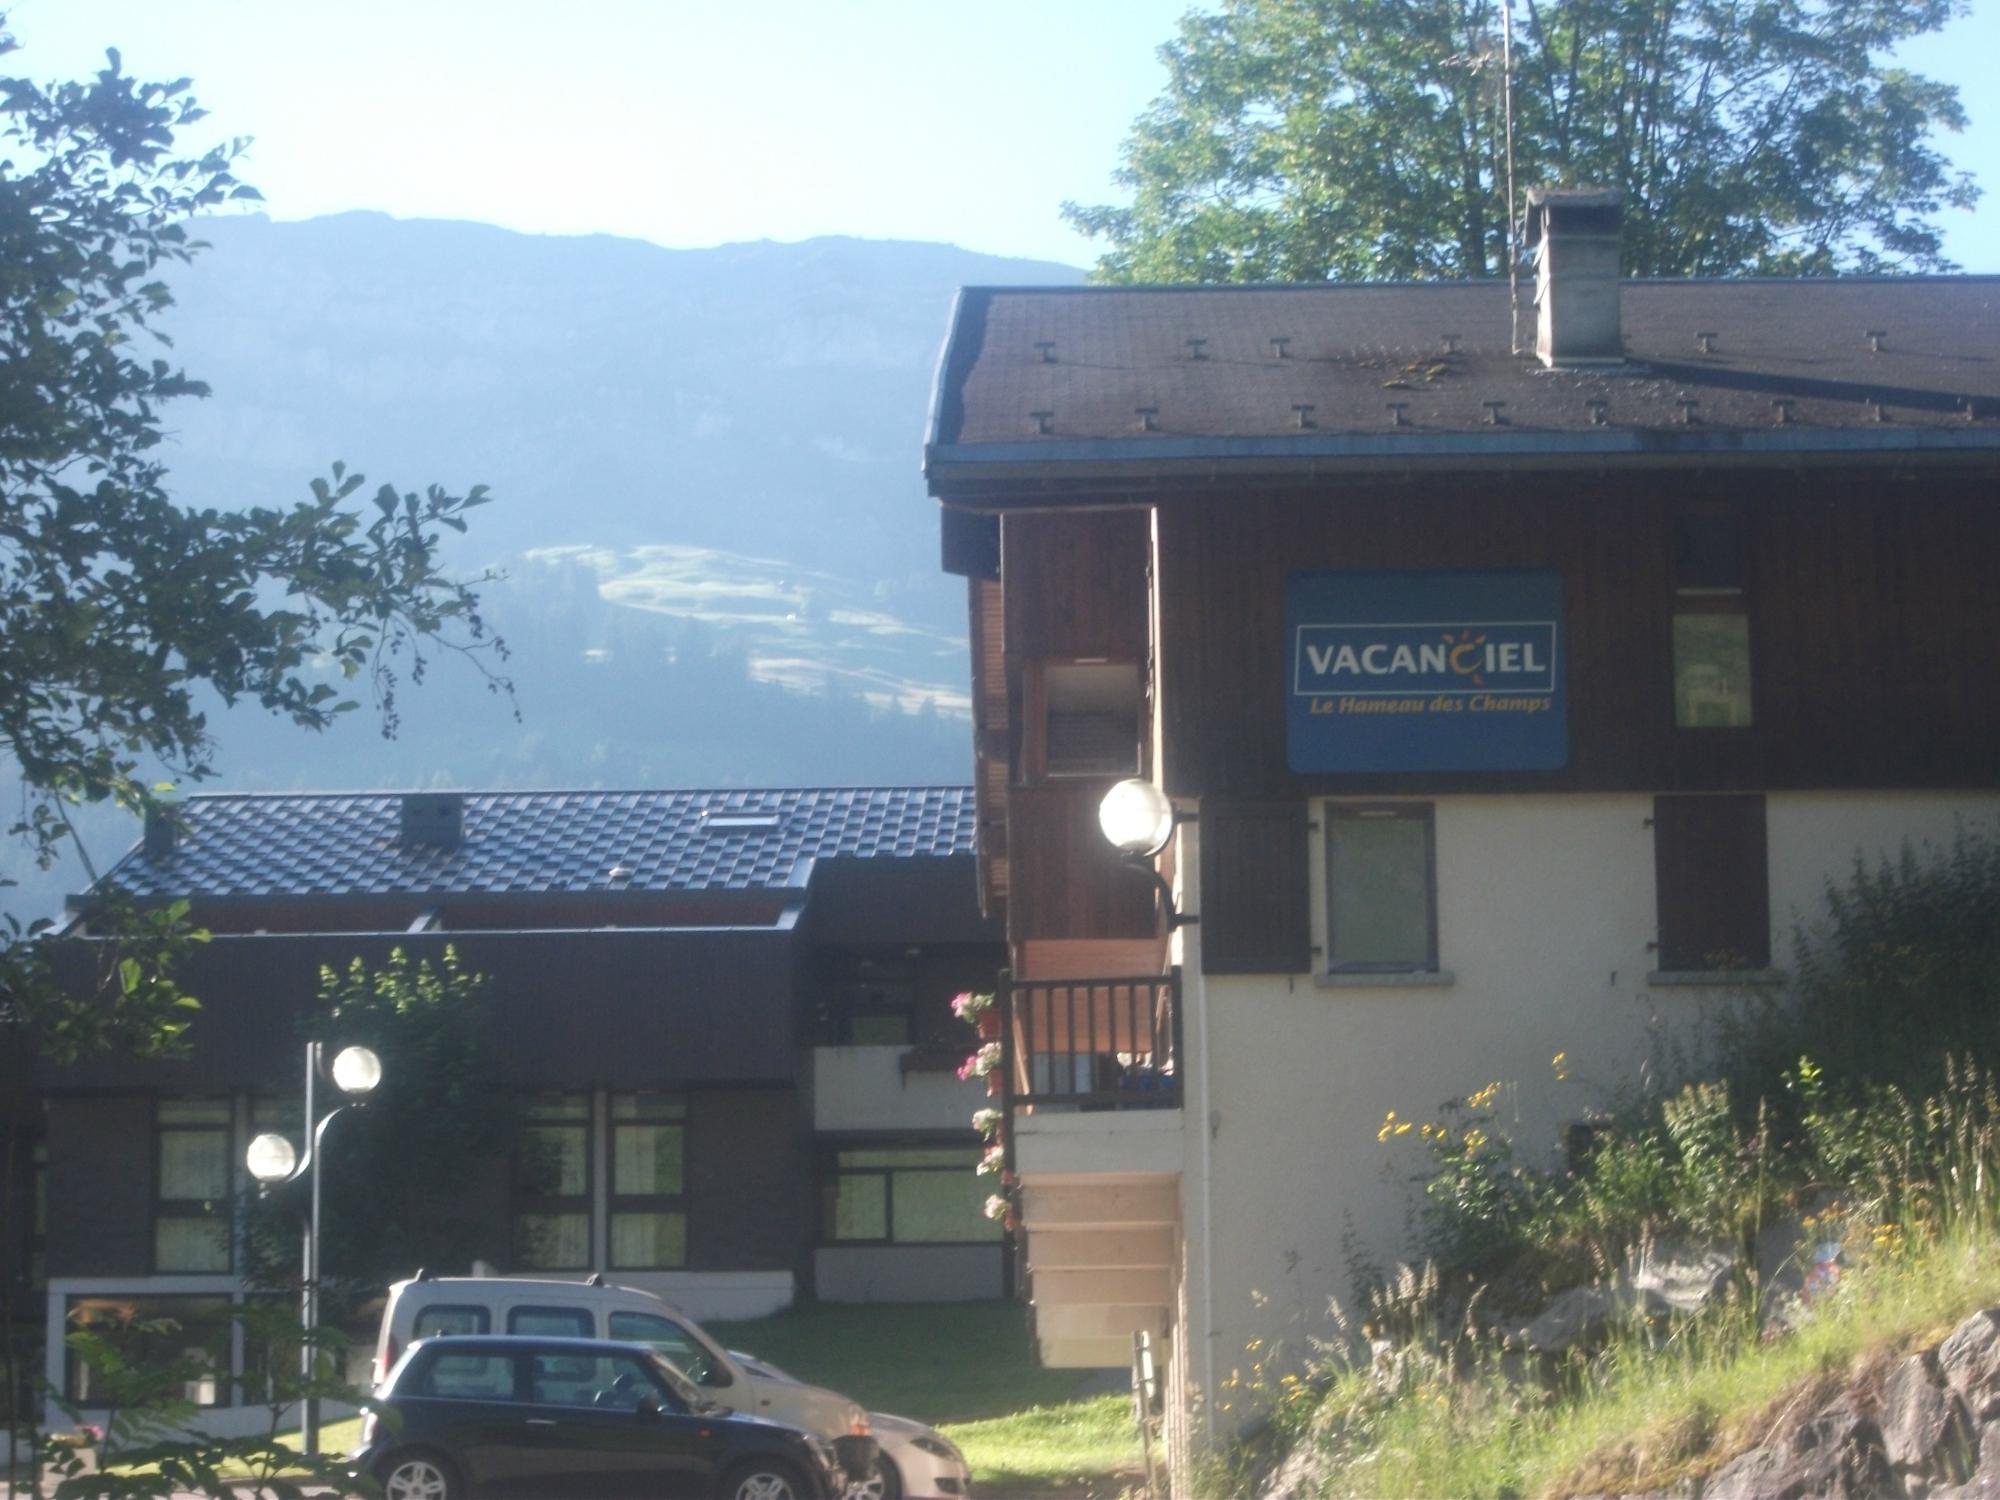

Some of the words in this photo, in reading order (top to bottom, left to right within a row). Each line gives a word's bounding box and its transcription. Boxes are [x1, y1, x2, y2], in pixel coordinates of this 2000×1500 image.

[1310, 697, 1334, 714] Le
[1339, 697, 1424, 713] Hameau
[1429, 695, 1463, 712] des
[1469, 694, 1551, 715] Champs
